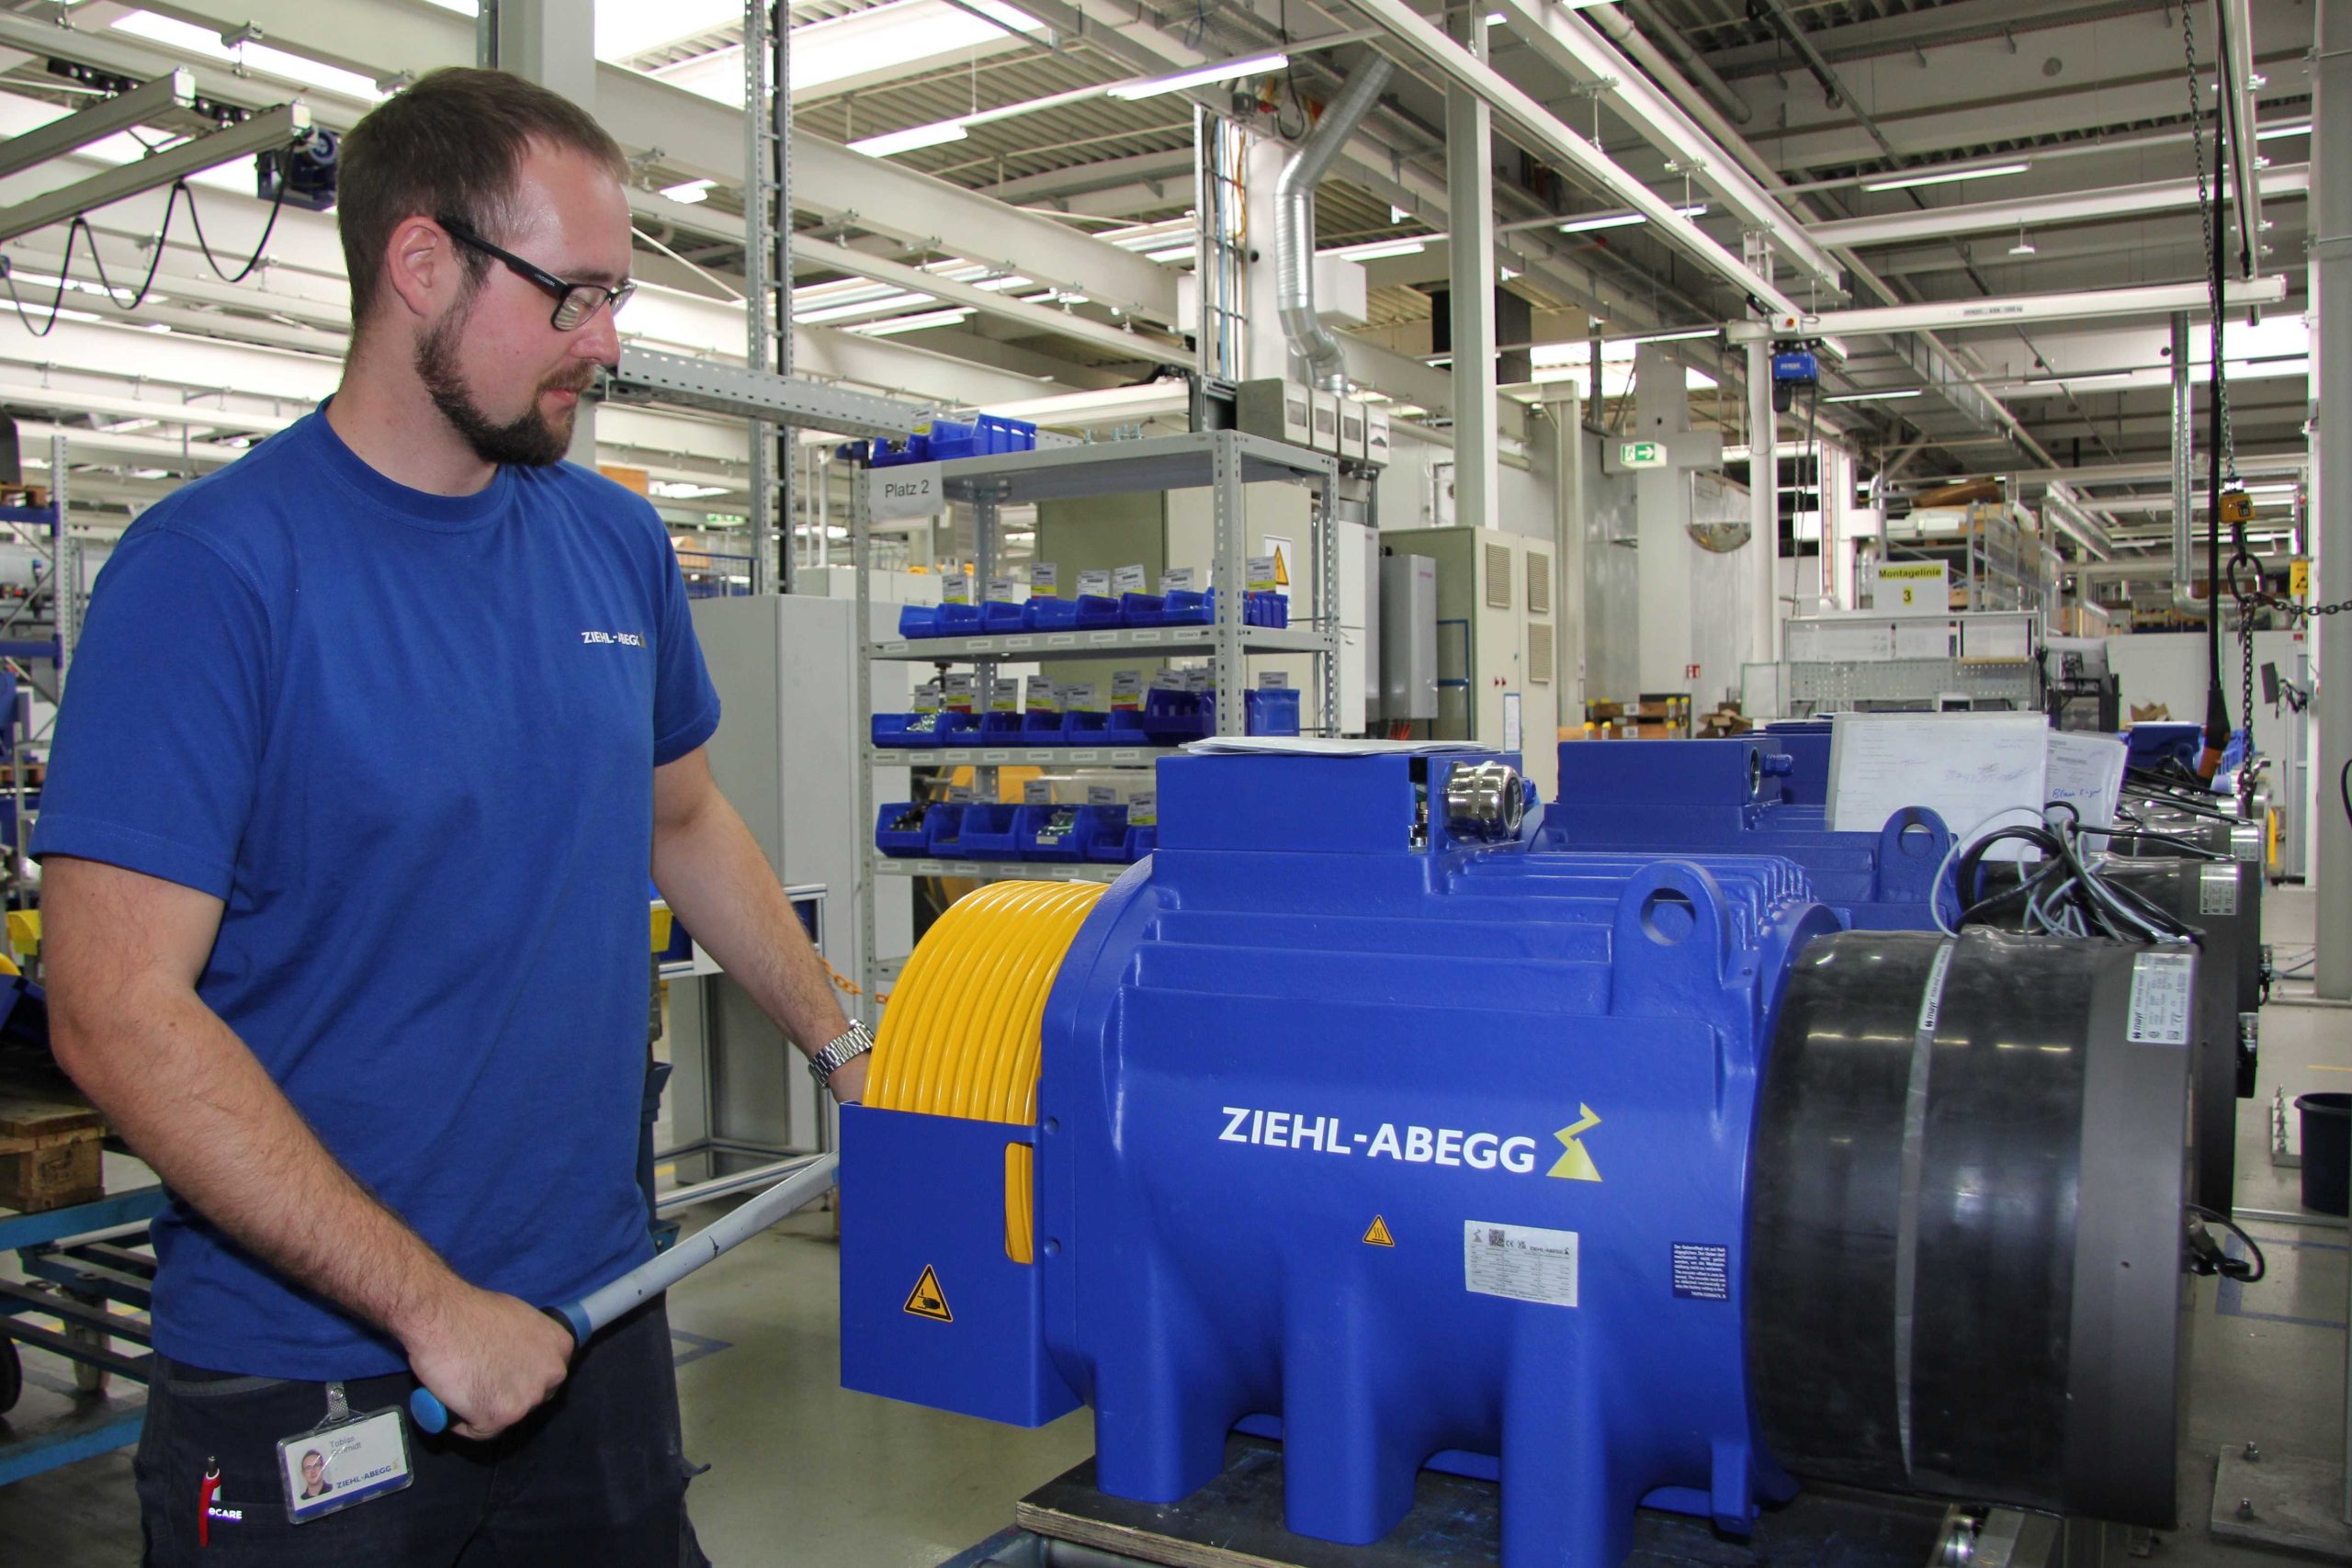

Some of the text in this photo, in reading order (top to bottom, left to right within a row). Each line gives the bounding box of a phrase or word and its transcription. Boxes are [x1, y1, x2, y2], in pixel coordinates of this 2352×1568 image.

[885, 479, 930, 498] Platz 2
[1878, 569, 1941, 579] Montagelinie
[1903, 590, 1911, 603] 3
[1218, 1106, 1535, 1174] ZIEHL-ABEGG
[336, 1464, 391, 1489] ZIEHL-ABEGG
